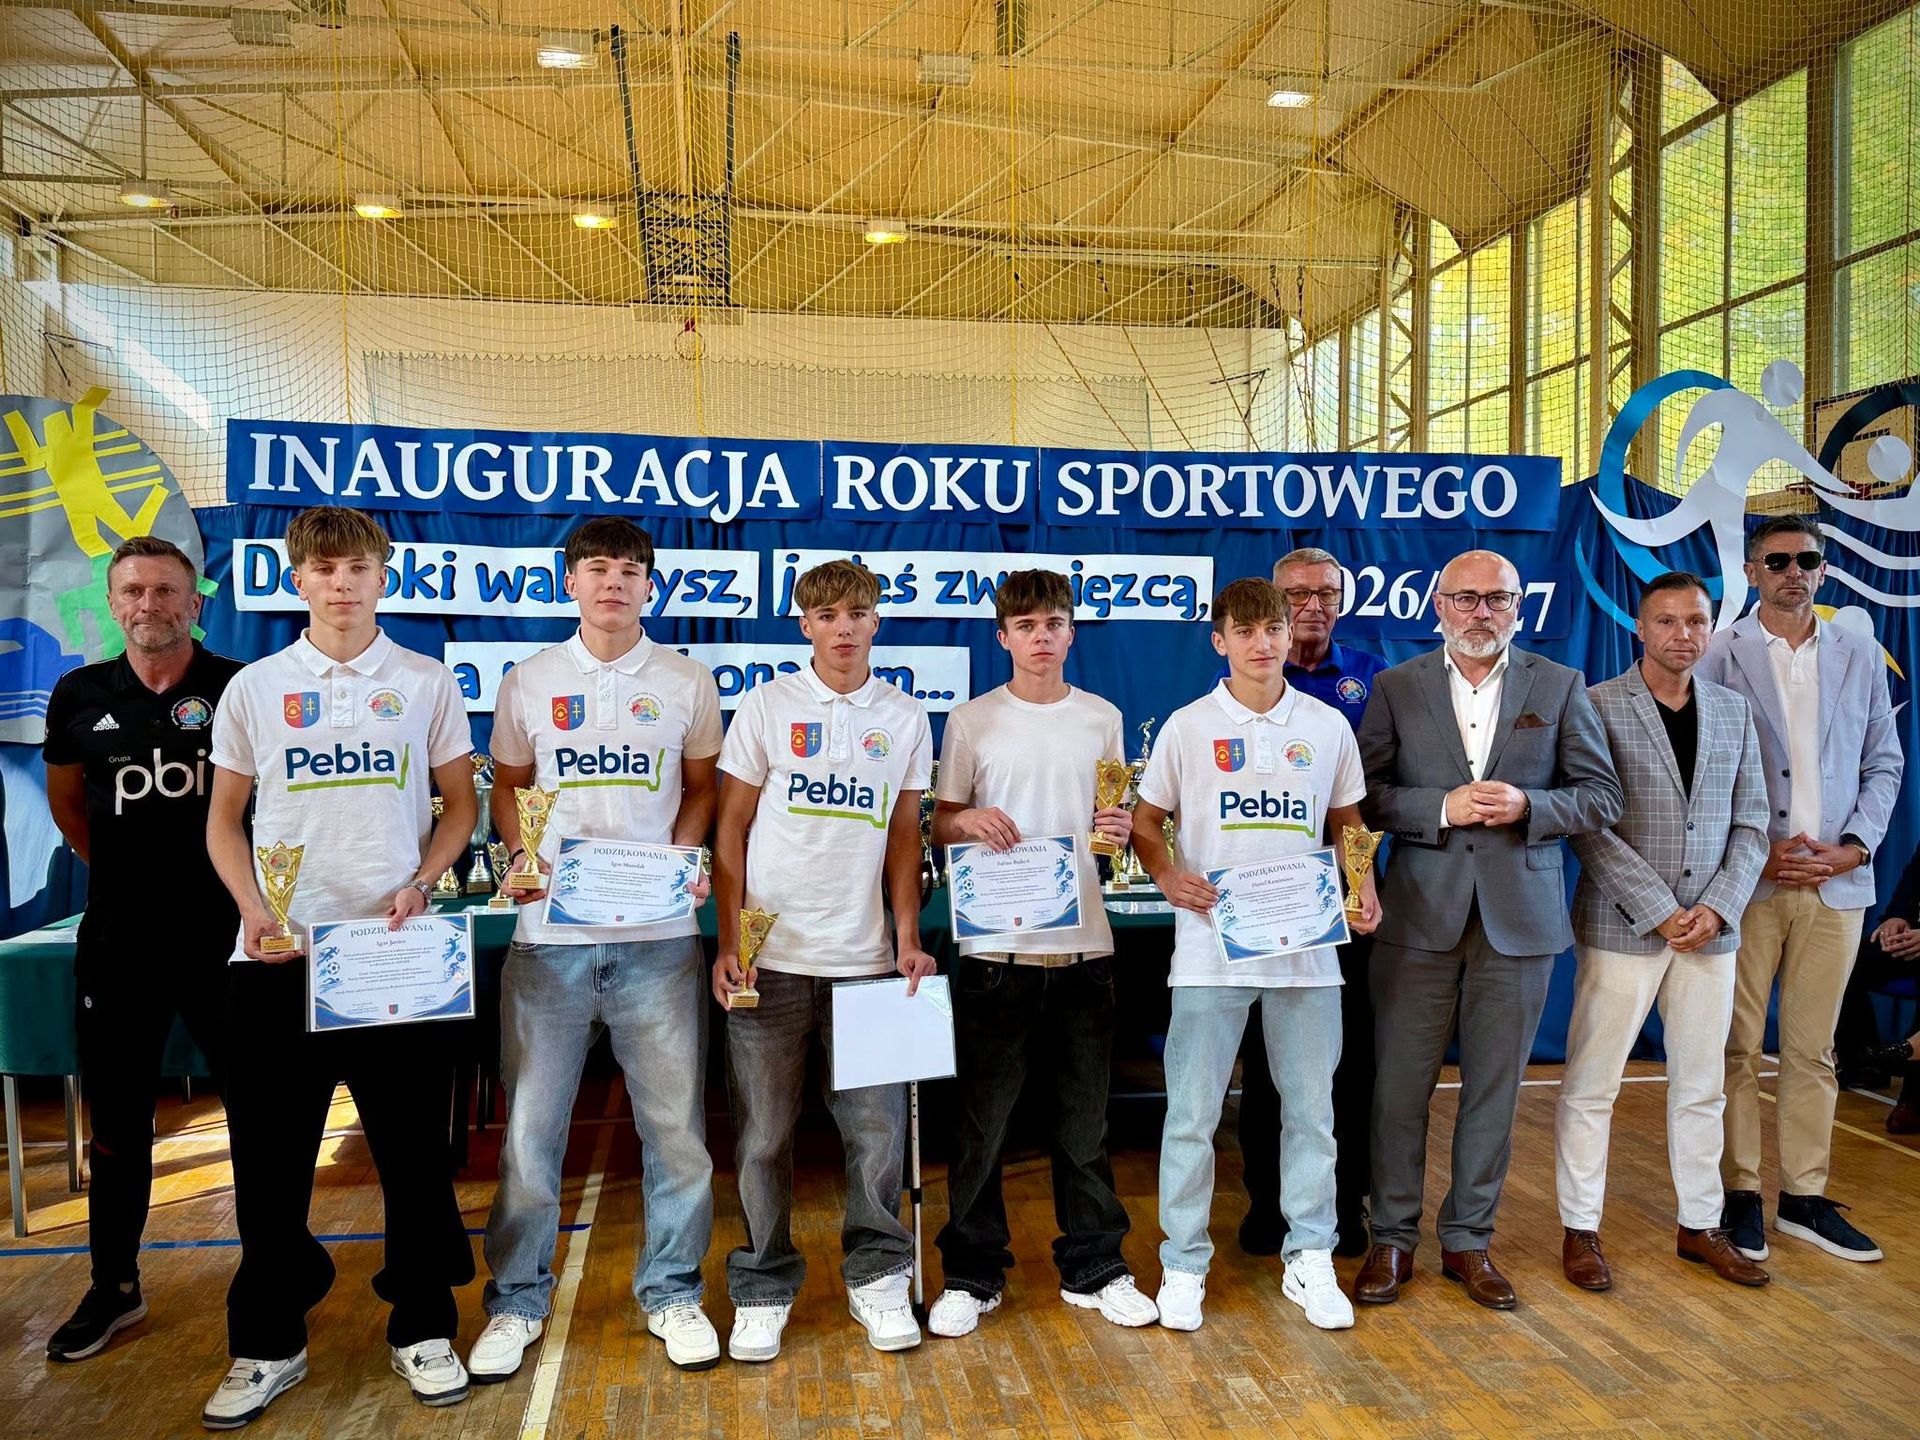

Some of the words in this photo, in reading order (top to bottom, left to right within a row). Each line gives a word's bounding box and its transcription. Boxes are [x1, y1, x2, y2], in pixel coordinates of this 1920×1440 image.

[248, 431, 800, 524] INAUGURACJA
[832, 454, 1032, 514] ROKU
[1057, 460, 1518, 520] SPORTOWEGO
[474, 550, 753, 618] walysz,
[935, 560, 1209, 621] zwięzcą,
[92, 723, 120, 731] adidas
[108, 755, 132, 763] Grupa
[285, 741, 395, 780] Pebia
[555, 744, 650, 777] Pebia
[115, 748, 207, 815] pbi
[788, 773, 875, 809] Pebia
[1220, 790, 1307, 820] Pebia
[593, 847, 668, 861] PODZIĘKOWANIA
[1238, 862, 1306, 880] PODZIĘKOWANIA
[350, 924, 434, 938] PODZIĘWANIA
